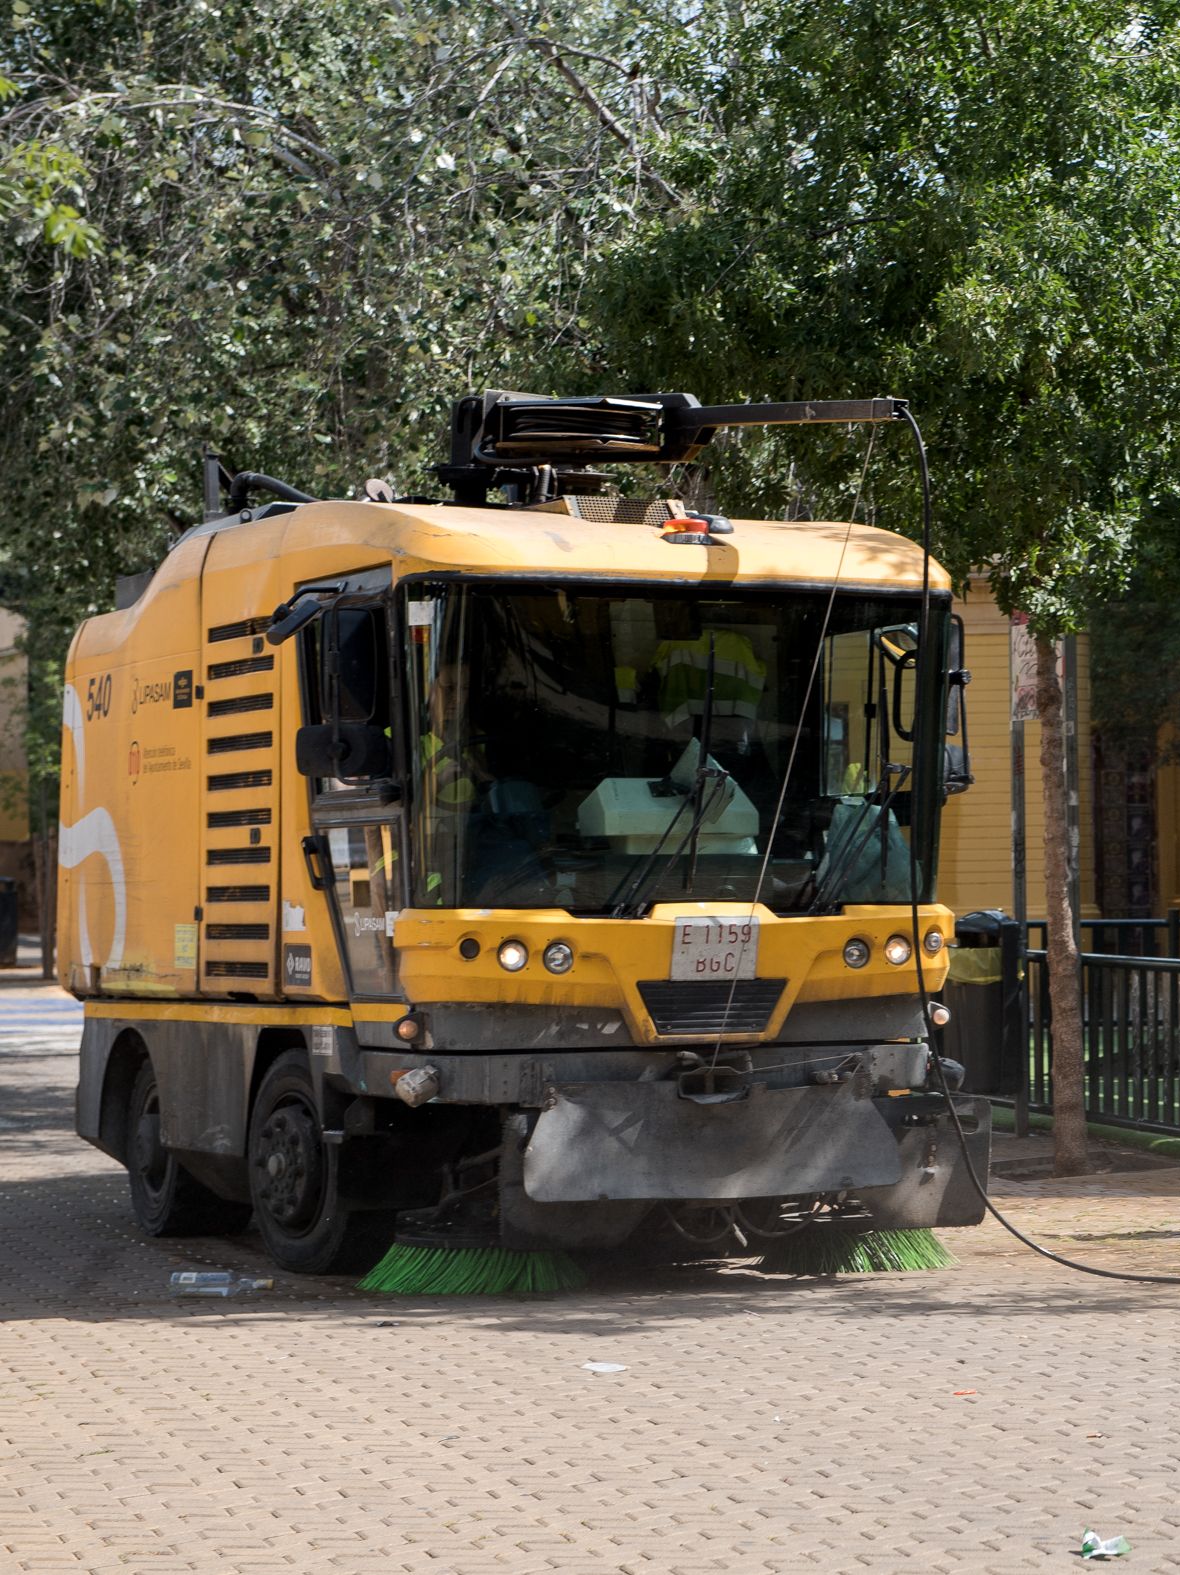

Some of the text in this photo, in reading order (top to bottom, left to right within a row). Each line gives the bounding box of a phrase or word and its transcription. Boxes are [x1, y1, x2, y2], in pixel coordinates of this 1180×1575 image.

[87, 674, 112, 722] 540
[681, 924, 752, 944] E 1159
